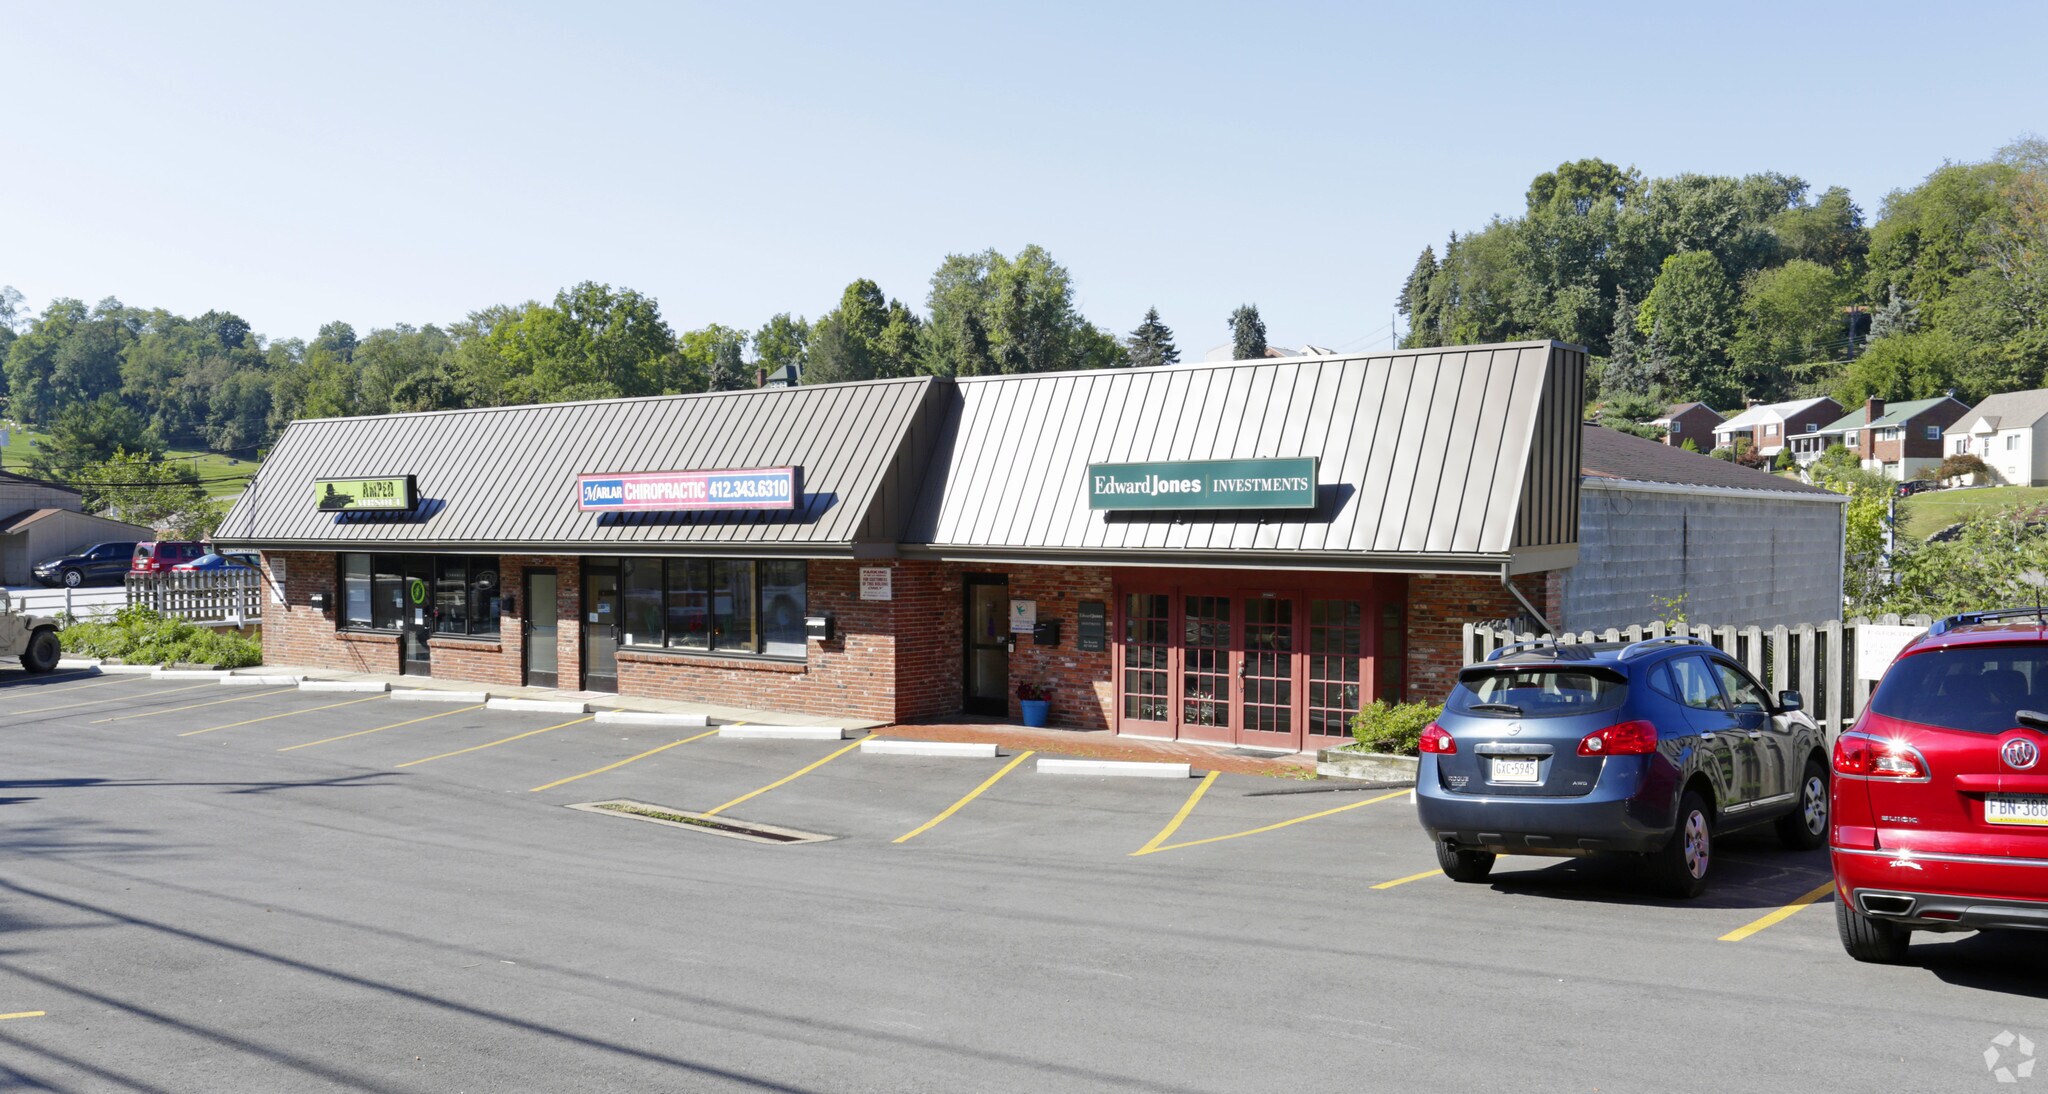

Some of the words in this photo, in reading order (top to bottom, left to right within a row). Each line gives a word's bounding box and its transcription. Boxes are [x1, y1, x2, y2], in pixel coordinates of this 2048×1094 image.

[362, 481, 395, 498] AMPED
[584, 484, 623, 502] MARLAR
[624, 481, 706, 500] CHIROPRACTIC
[709, 479, 788, 499] 412.343.6310
[1213, 477, 1309, 493] INVESTMENTS
[1881, 815, 1919, 824] BUICK
